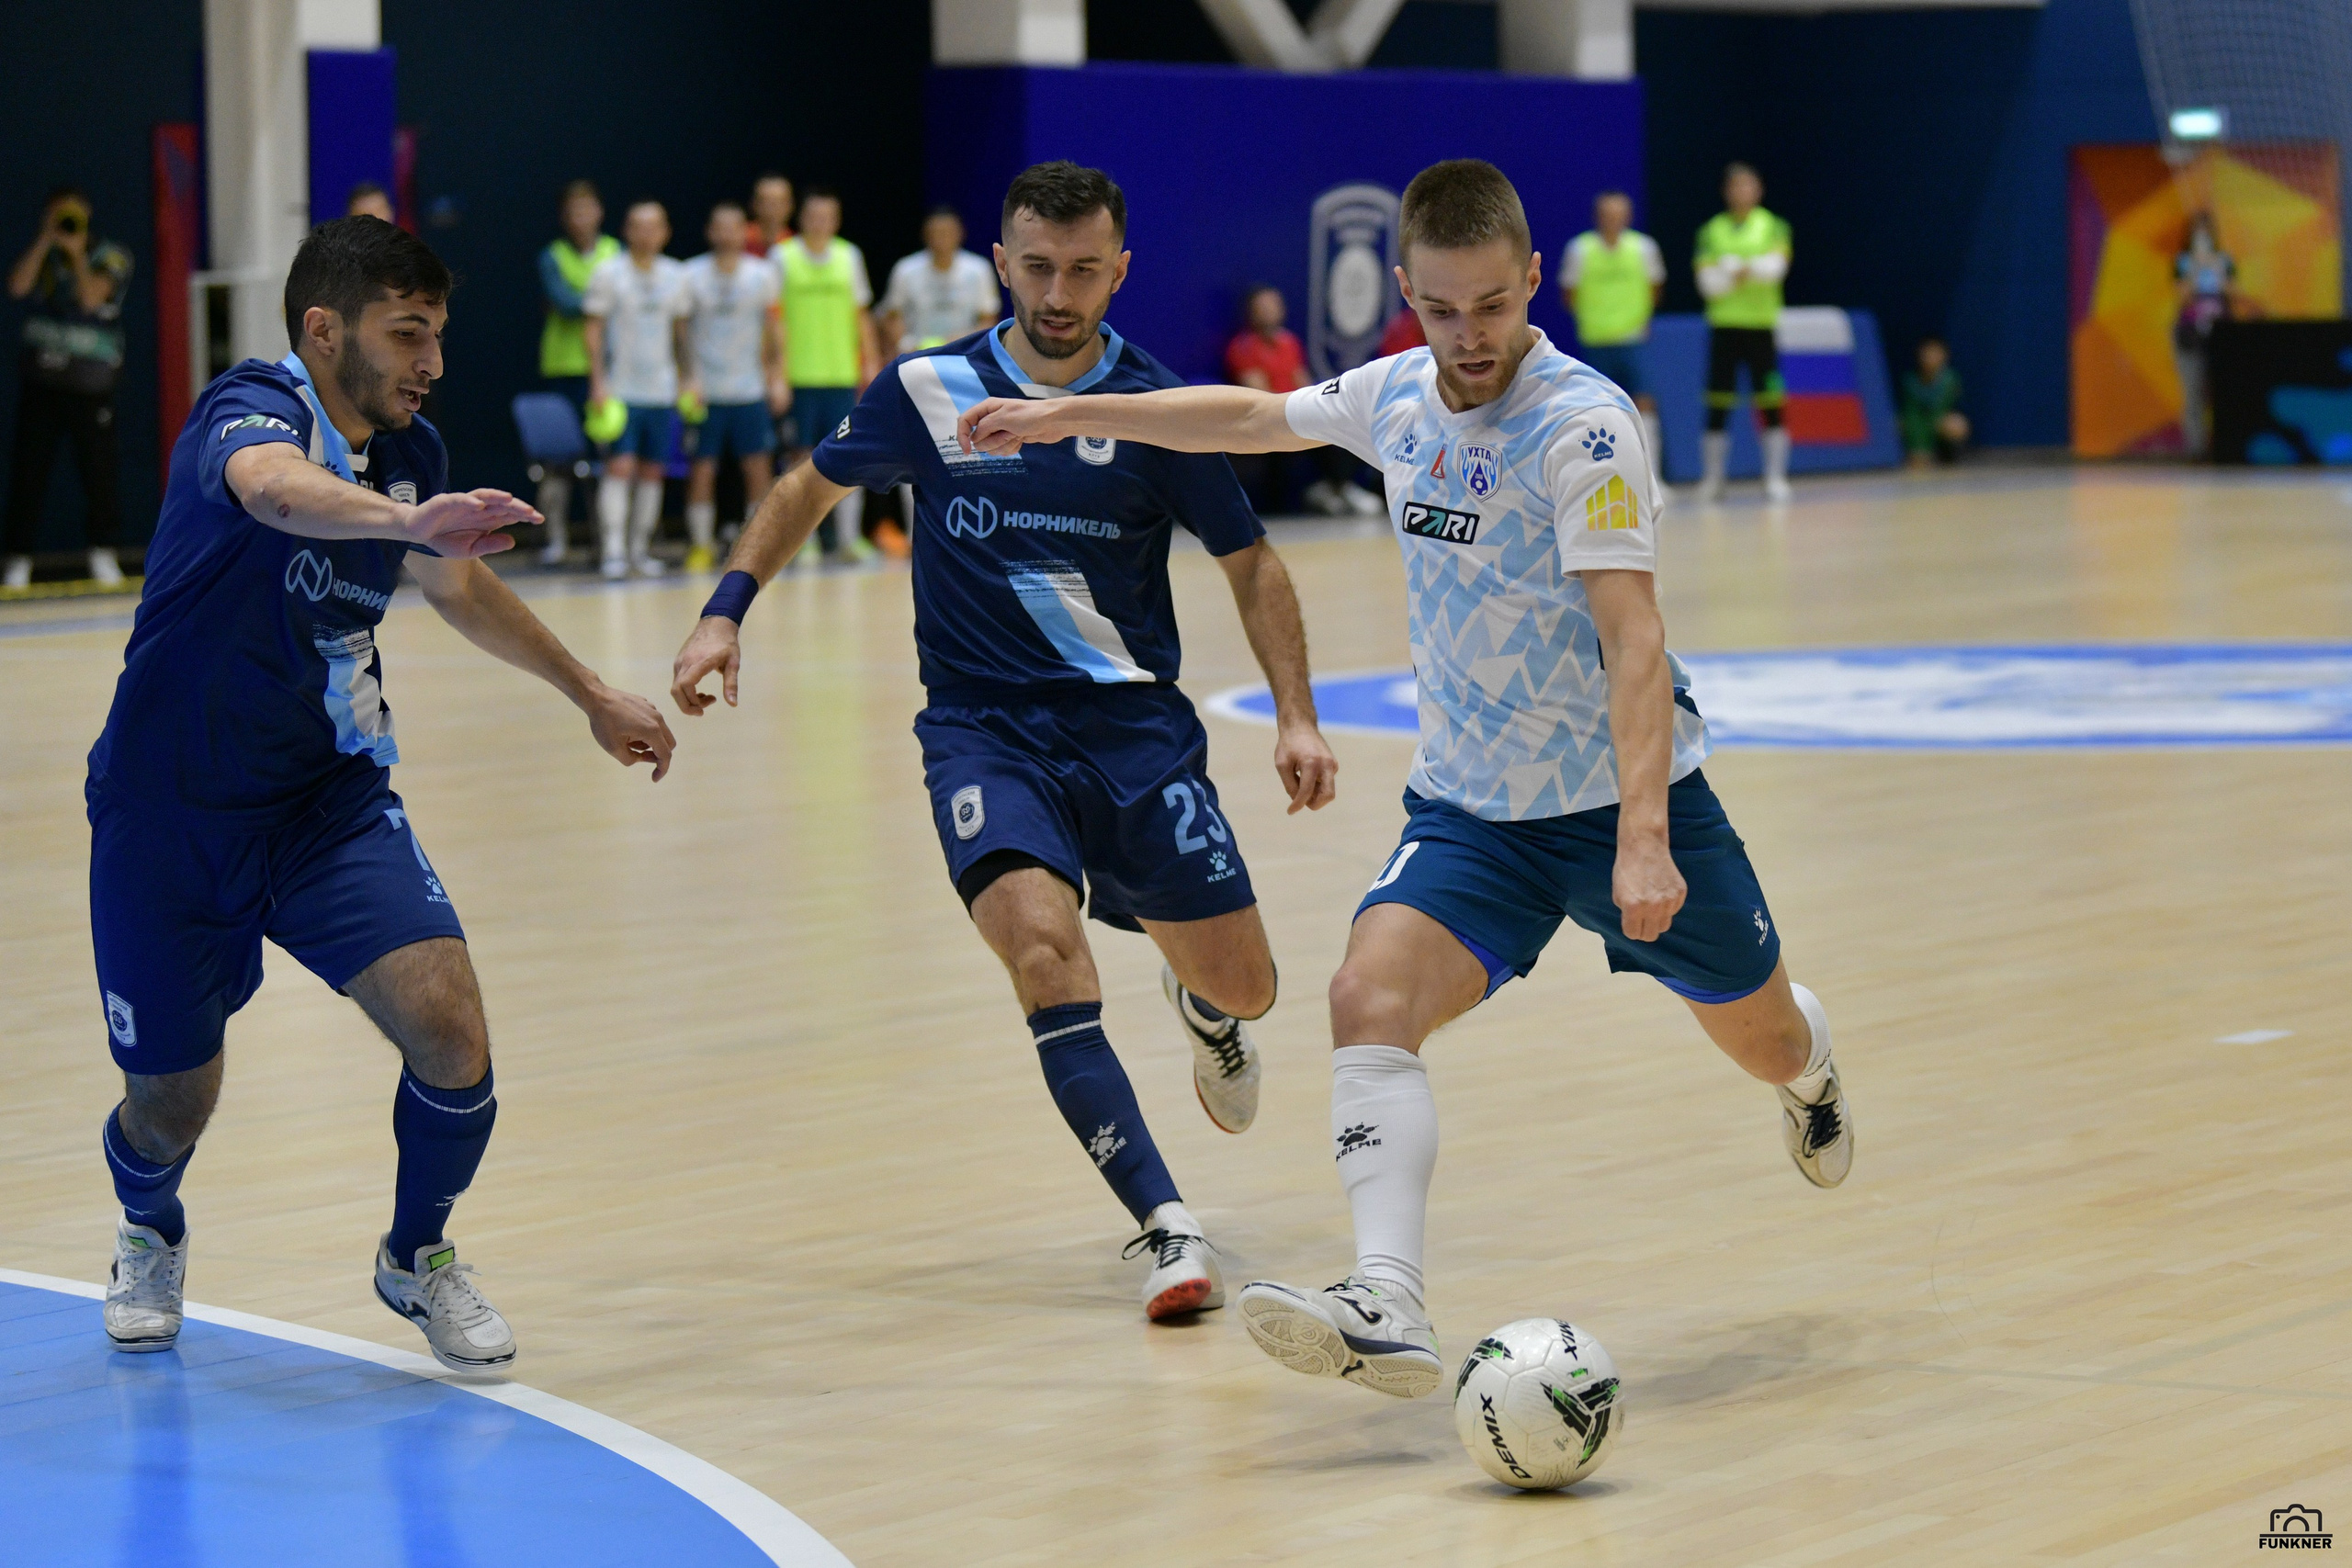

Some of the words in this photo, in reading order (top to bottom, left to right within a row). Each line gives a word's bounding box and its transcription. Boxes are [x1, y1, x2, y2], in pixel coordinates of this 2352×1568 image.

[1002, 511, 1121, 539] НОРНИКЕЛЬ
[1404, 505, 1476, 541] PARI
[1206, 868, 1237, 883] KELME
[1096, 1135, 1127, 1168] KELME
[1335, 1138, 1382, 1163] KELME
[1480, 1393, 1533, 1479] DEMIX
